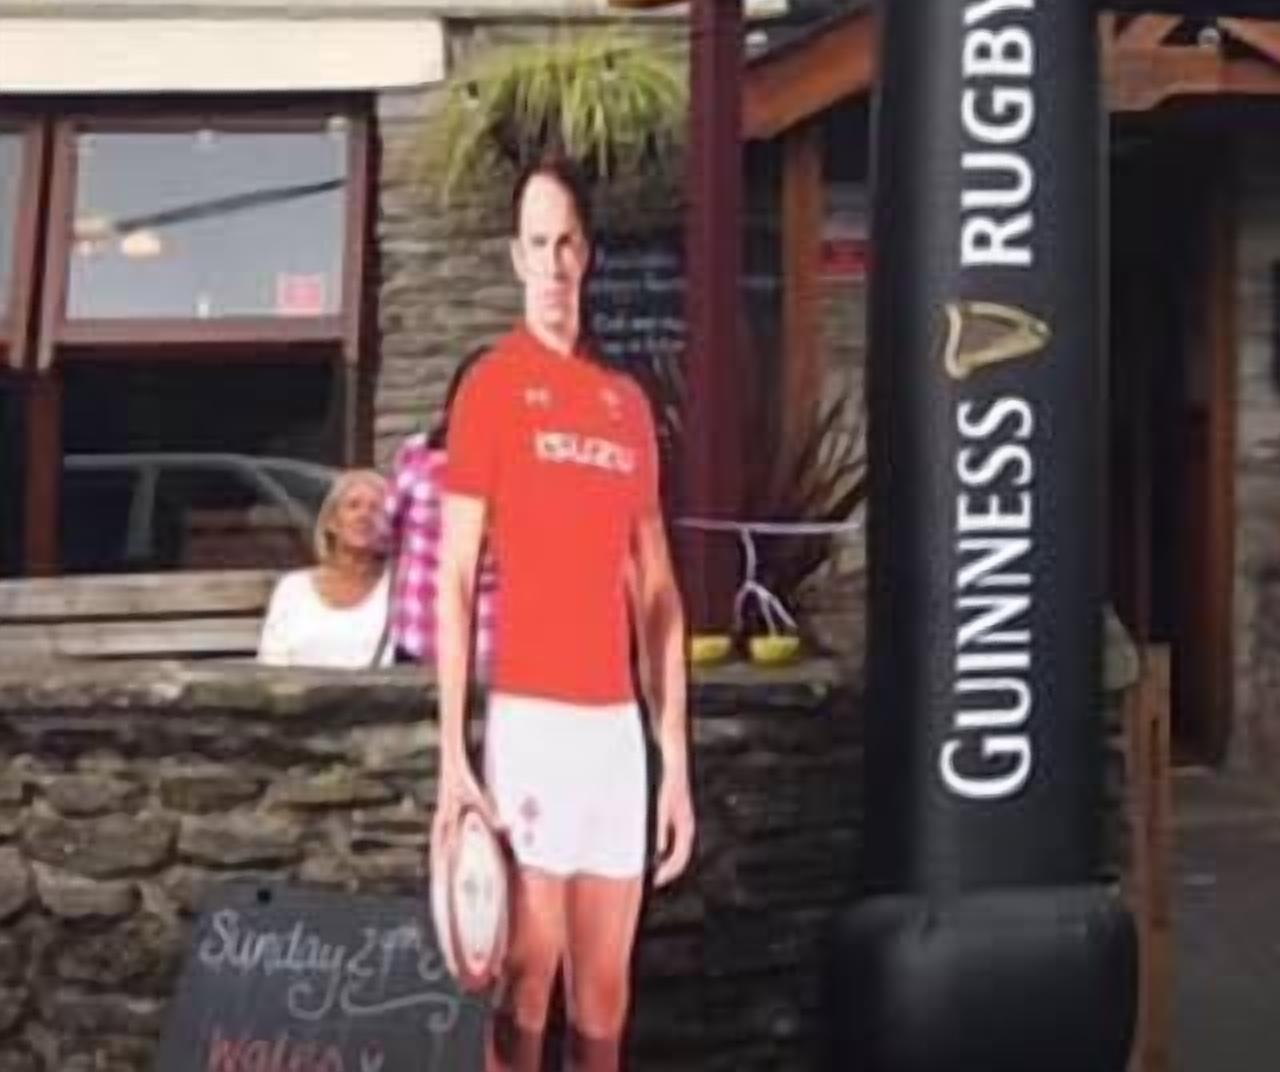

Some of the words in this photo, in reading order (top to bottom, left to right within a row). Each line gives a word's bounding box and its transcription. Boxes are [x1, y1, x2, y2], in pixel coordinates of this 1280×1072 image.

[536, 431, 634, 473] ISUZU
[940, 396, 1034, 799] GUINNESS
[200, 909, 346, 1020] Sunday
